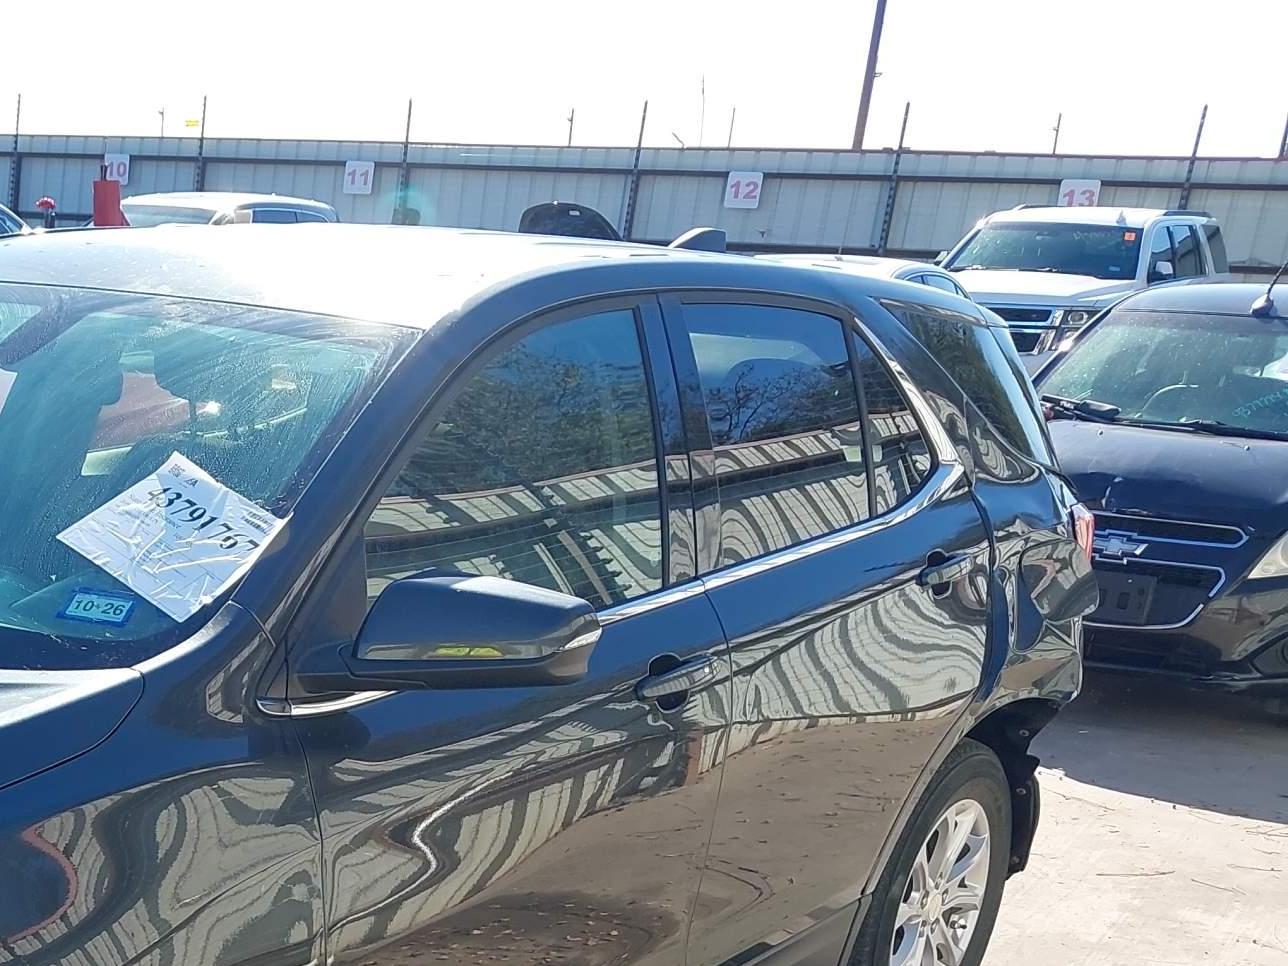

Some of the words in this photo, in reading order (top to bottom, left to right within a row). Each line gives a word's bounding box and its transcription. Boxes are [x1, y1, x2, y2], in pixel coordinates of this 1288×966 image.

[108, 161, 128, 177] 10
[347, 168, 369, 186] 11
[730, 180, 759, 200] 12
[1062, 189, 1097, 207] 13
[146, 487, 261, 552] 43791767
